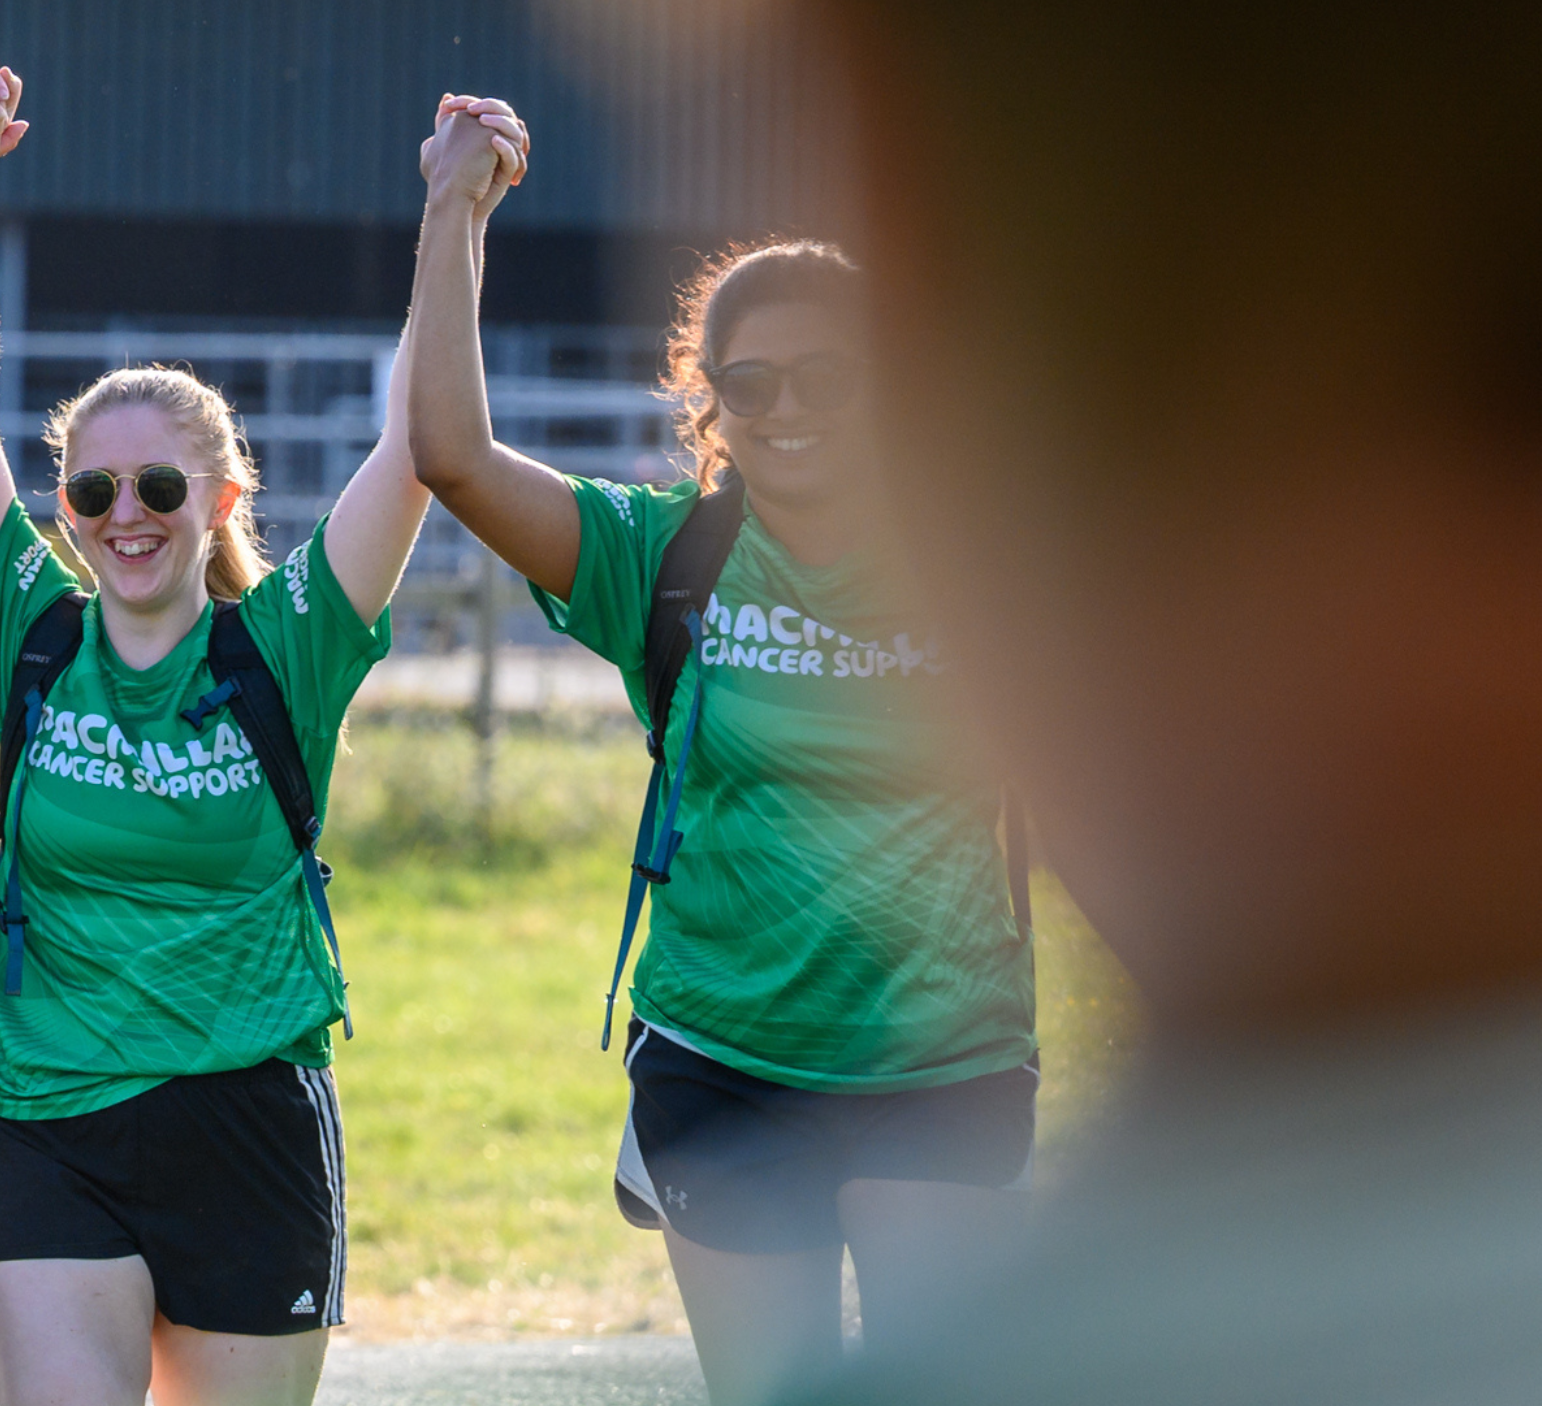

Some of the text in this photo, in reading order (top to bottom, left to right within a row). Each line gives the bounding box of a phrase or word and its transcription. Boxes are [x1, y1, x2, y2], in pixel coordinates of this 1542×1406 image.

[701, 638, 824, 677] CANCER
[28, 740, 261, 799] CANCER SUPPORT
